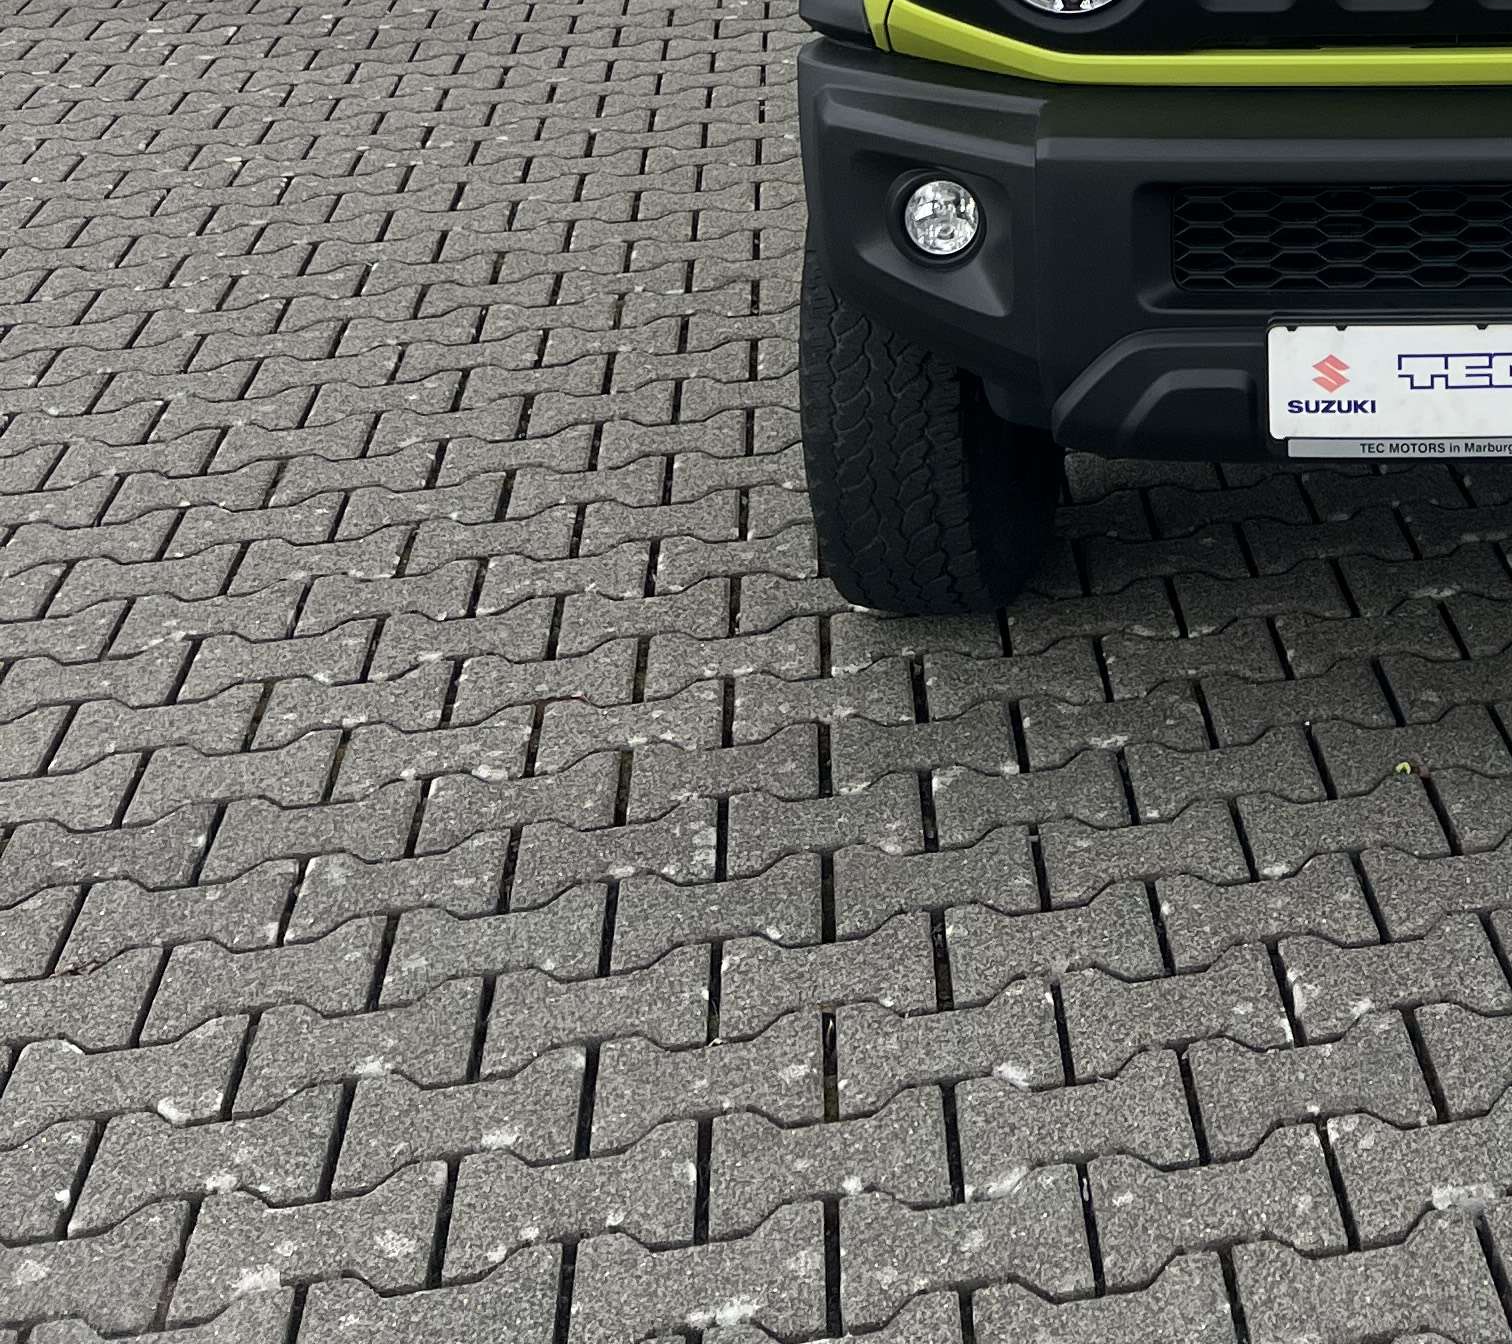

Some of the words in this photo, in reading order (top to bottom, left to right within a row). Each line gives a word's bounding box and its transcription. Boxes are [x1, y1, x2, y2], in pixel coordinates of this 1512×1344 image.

[1287, 399, 1377, 414] SUZUKI
[1360, 443, 1385, 454] TEC
[1389, 443, 1446, 454] MOTORS
[1450, 442, 1461, 453] in
